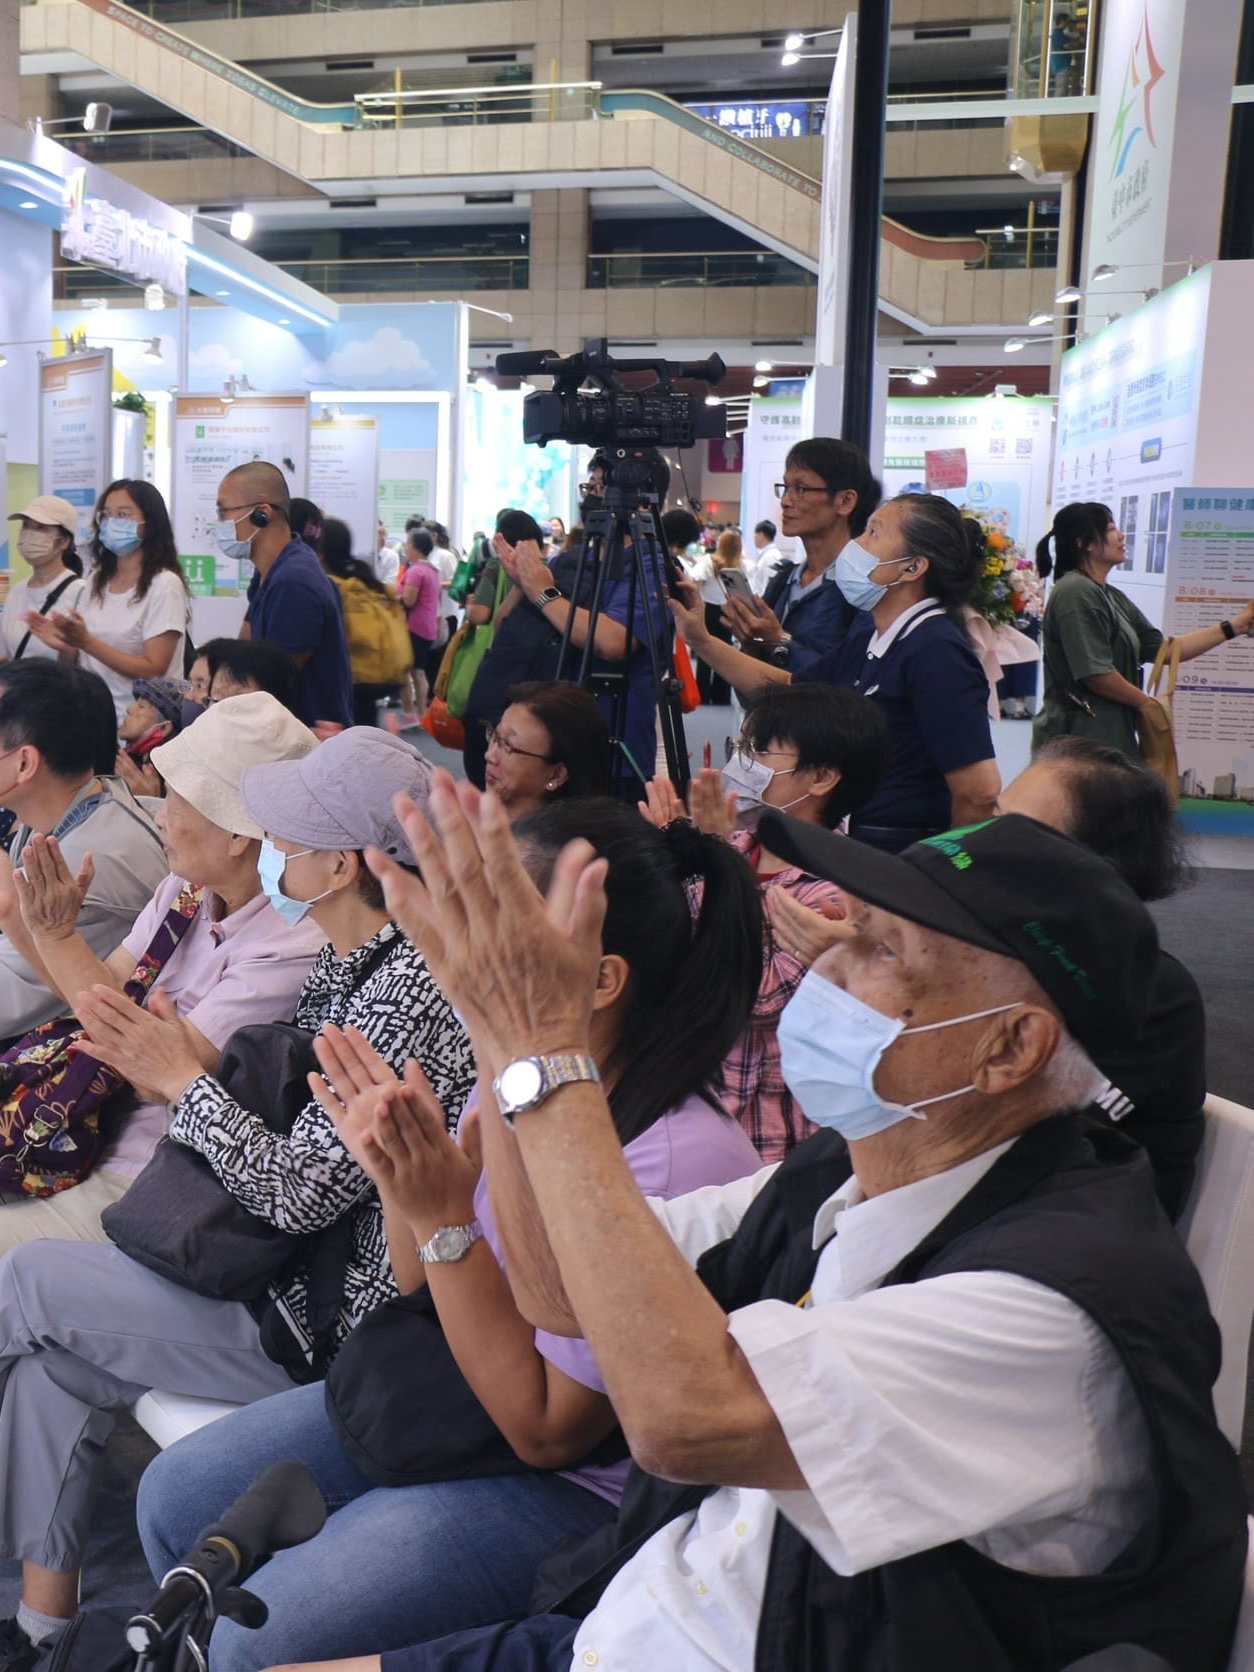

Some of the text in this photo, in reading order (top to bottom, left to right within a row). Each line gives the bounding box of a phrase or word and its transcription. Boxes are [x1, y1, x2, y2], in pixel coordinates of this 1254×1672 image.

[702, 129, 818, 197] AND COLLABORATE TO
